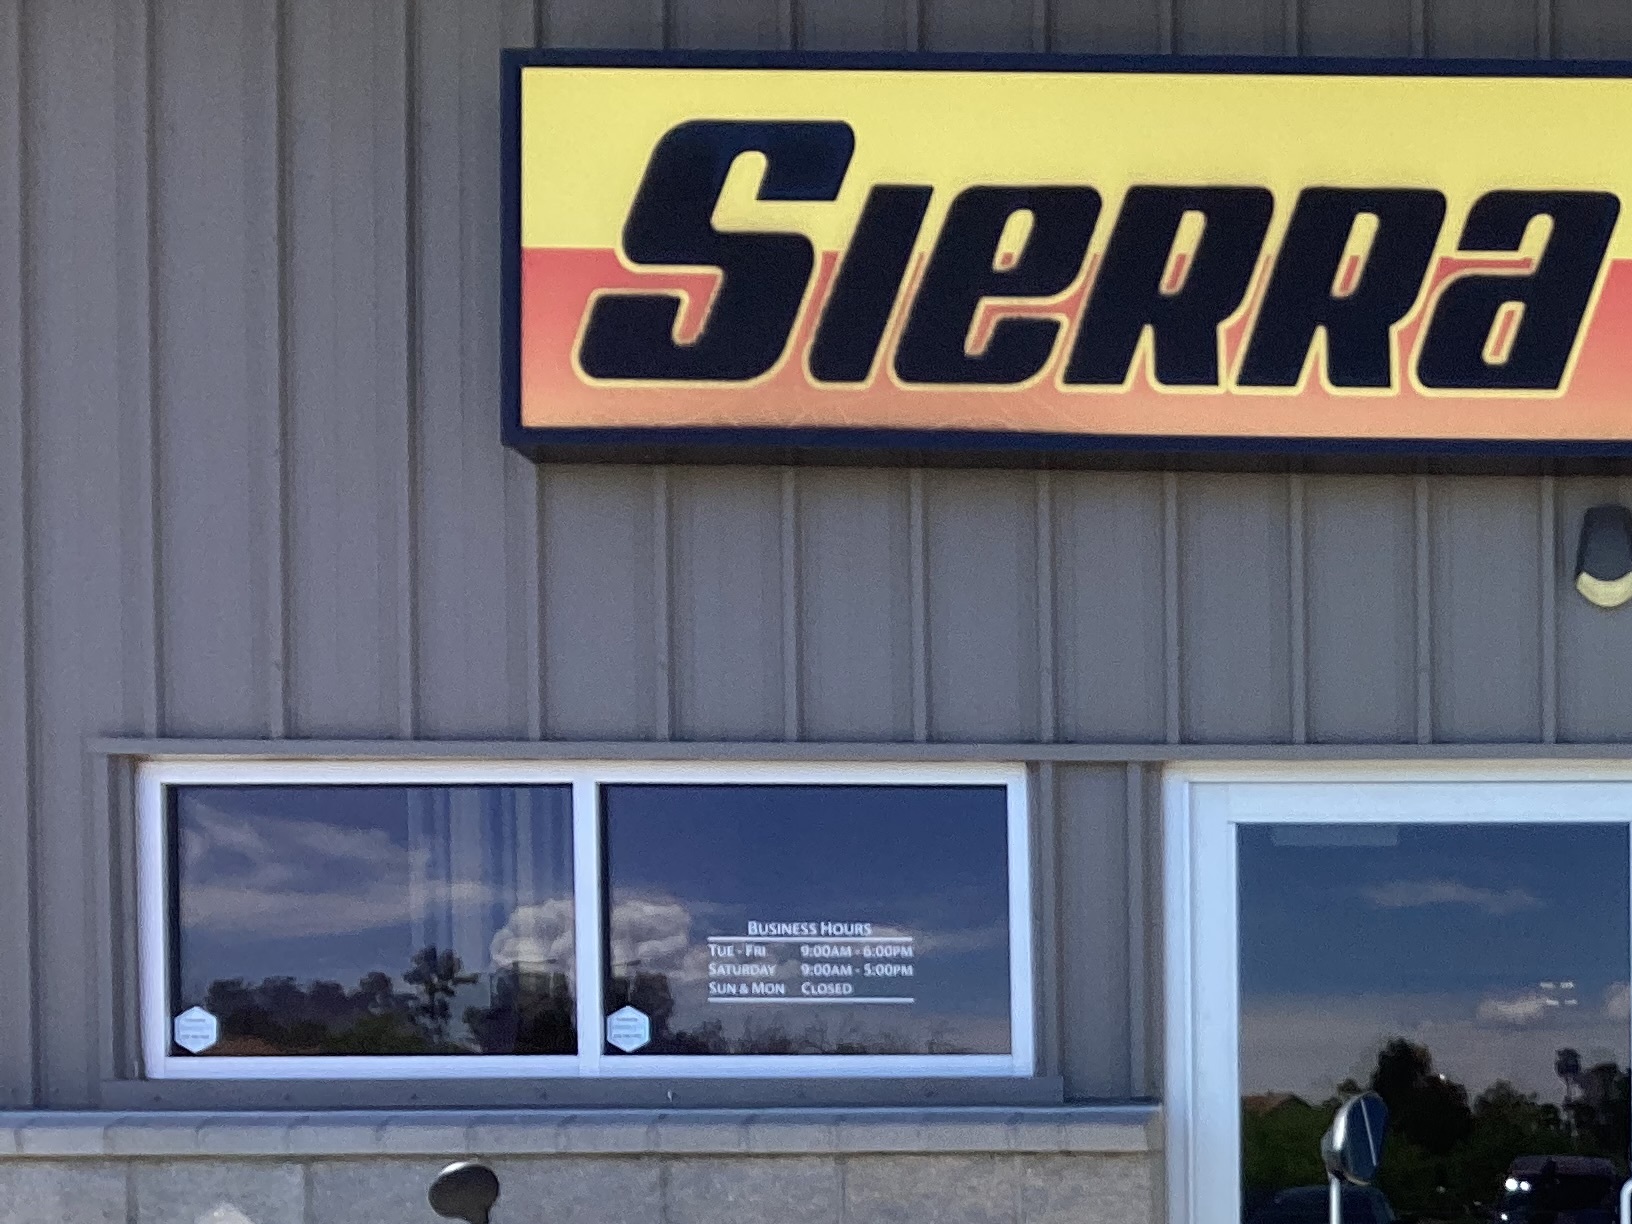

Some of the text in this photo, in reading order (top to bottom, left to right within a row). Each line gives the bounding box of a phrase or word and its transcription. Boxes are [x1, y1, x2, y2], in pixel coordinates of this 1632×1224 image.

[747, 920, 873, 937] BUSINESS HOURS
[708, 944, 735, 958] TUE
[745, 944, 767, 958] FRI
[708, 963, 776, 976] SATURDAY
[708, 982, 738, 995] SUN
[751, 982, 786, 995] MON
[801, 982, 853, 995] CLOSED
